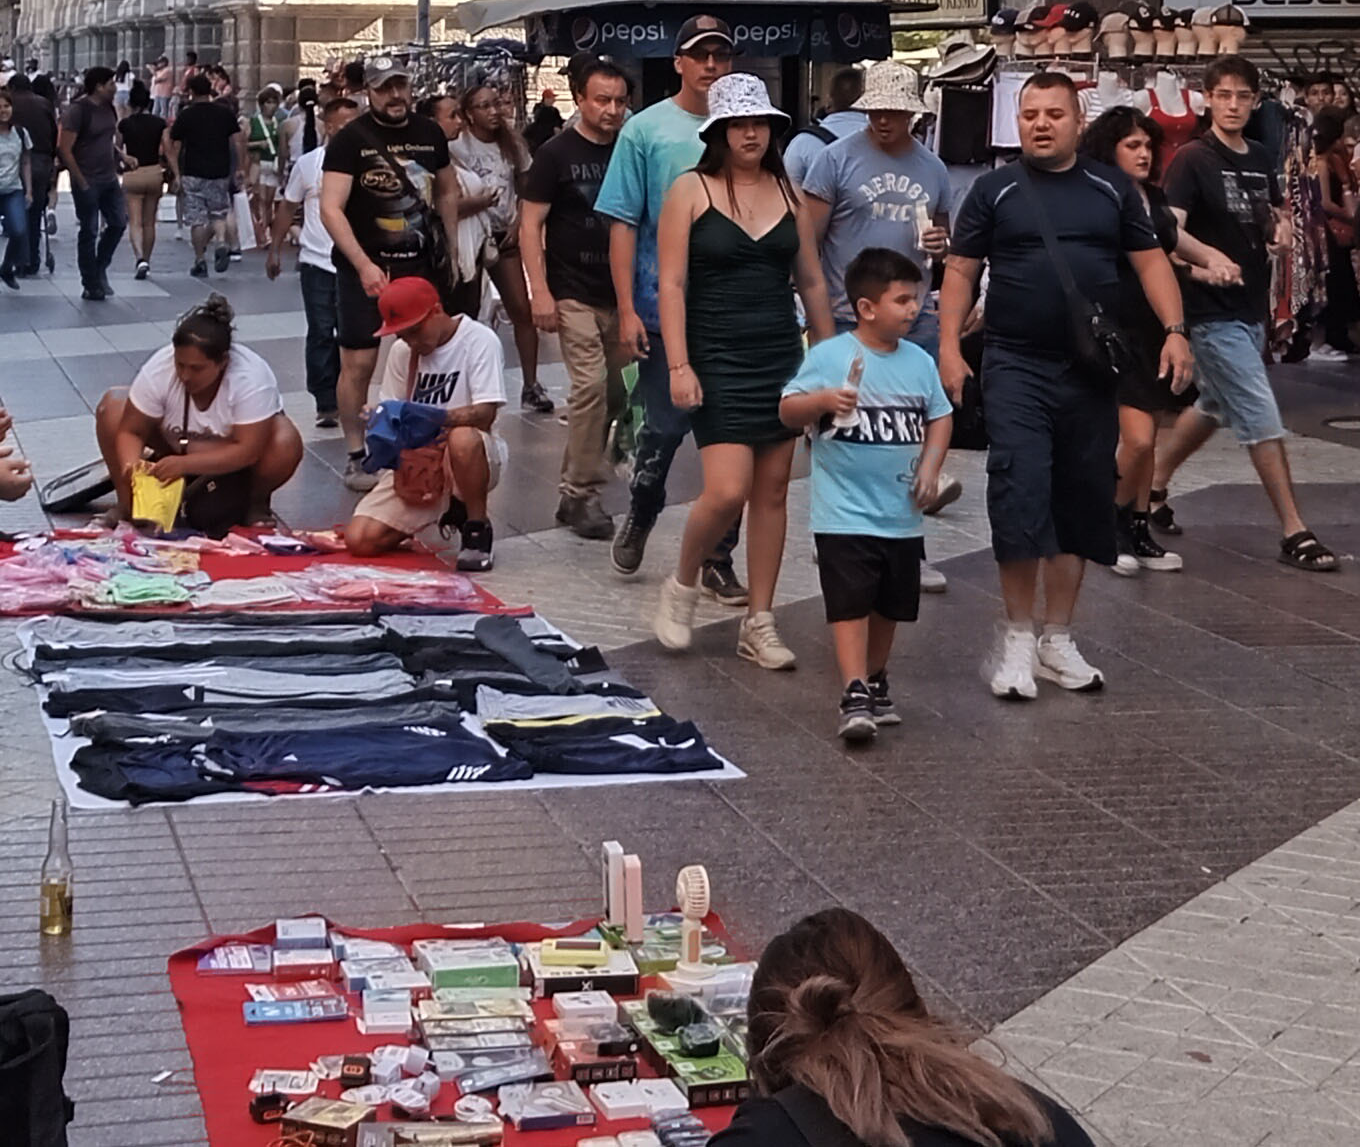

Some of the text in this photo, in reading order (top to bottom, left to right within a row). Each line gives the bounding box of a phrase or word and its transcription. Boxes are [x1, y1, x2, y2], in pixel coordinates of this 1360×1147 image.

[601, 21, 666, 44] pepsi
[733, 19, 798, 45] pepsi
[570, 163, 606, 180] PAR
[871, 201, 913, 222] NYC
